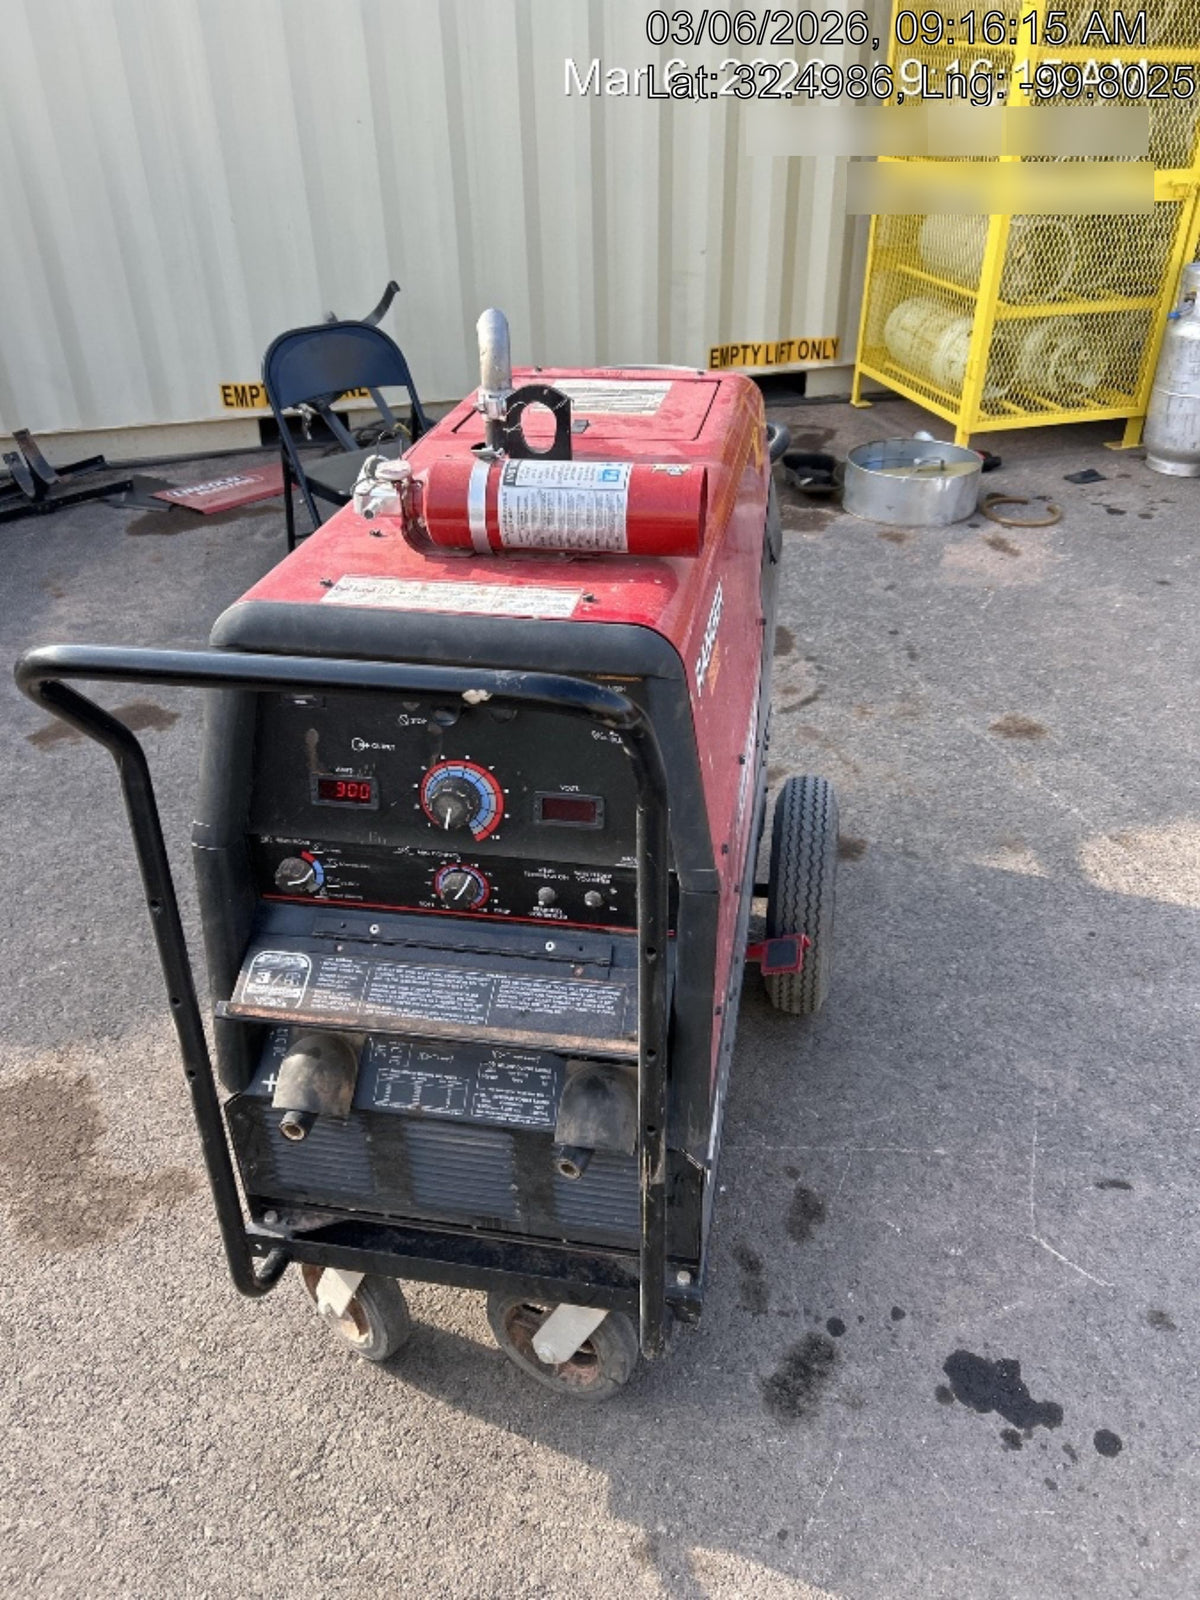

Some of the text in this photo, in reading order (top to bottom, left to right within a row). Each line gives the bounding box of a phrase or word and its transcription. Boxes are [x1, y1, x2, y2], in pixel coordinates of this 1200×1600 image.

[710, 338, 840, 369] EMPTY LIFT ONLY
[221, 384, 270, 408] EMPT
[335, 781, 371, 799] 300
